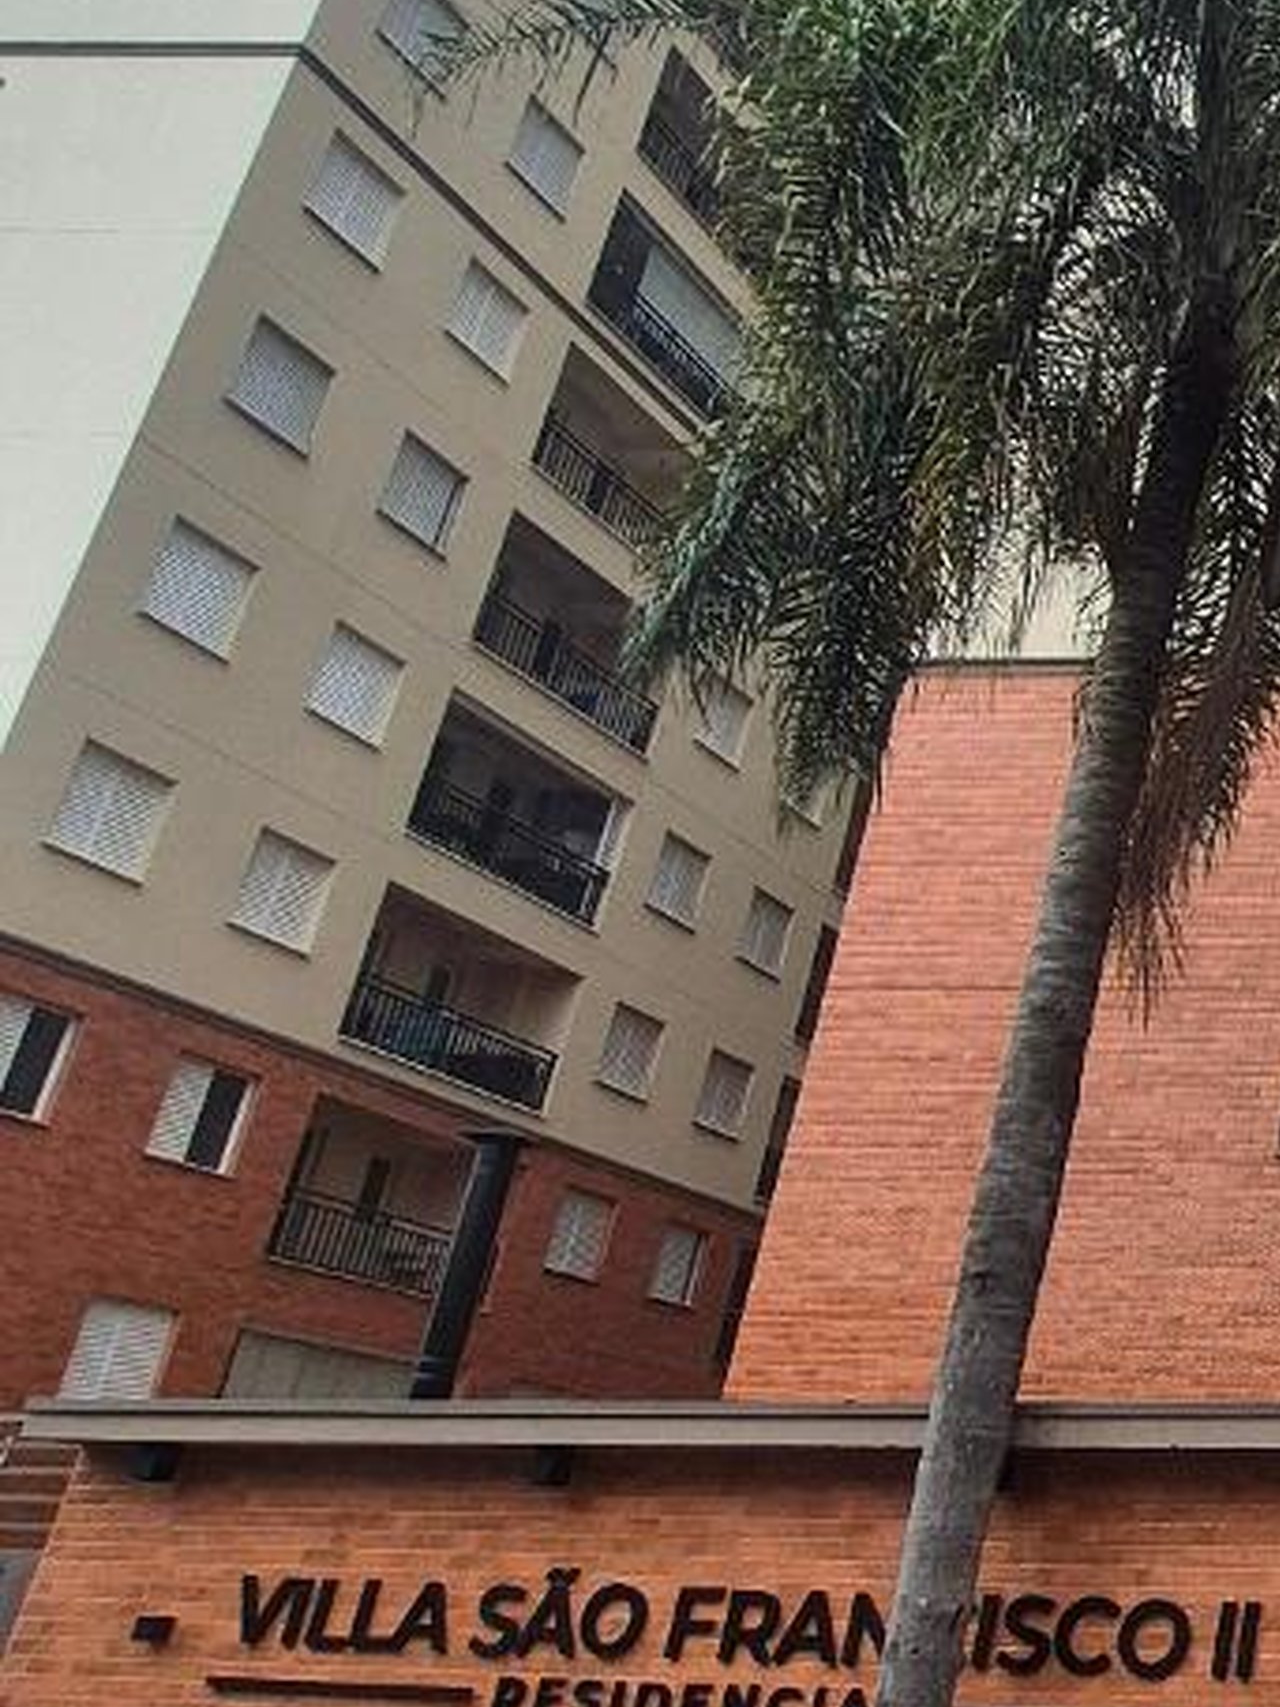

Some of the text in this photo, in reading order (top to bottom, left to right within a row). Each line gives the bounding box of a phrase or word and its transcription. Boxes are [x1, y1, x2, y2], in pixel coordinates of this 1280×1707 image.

[239, 1567, 1262, 1684] VILLA SÃO FRANISCO II
